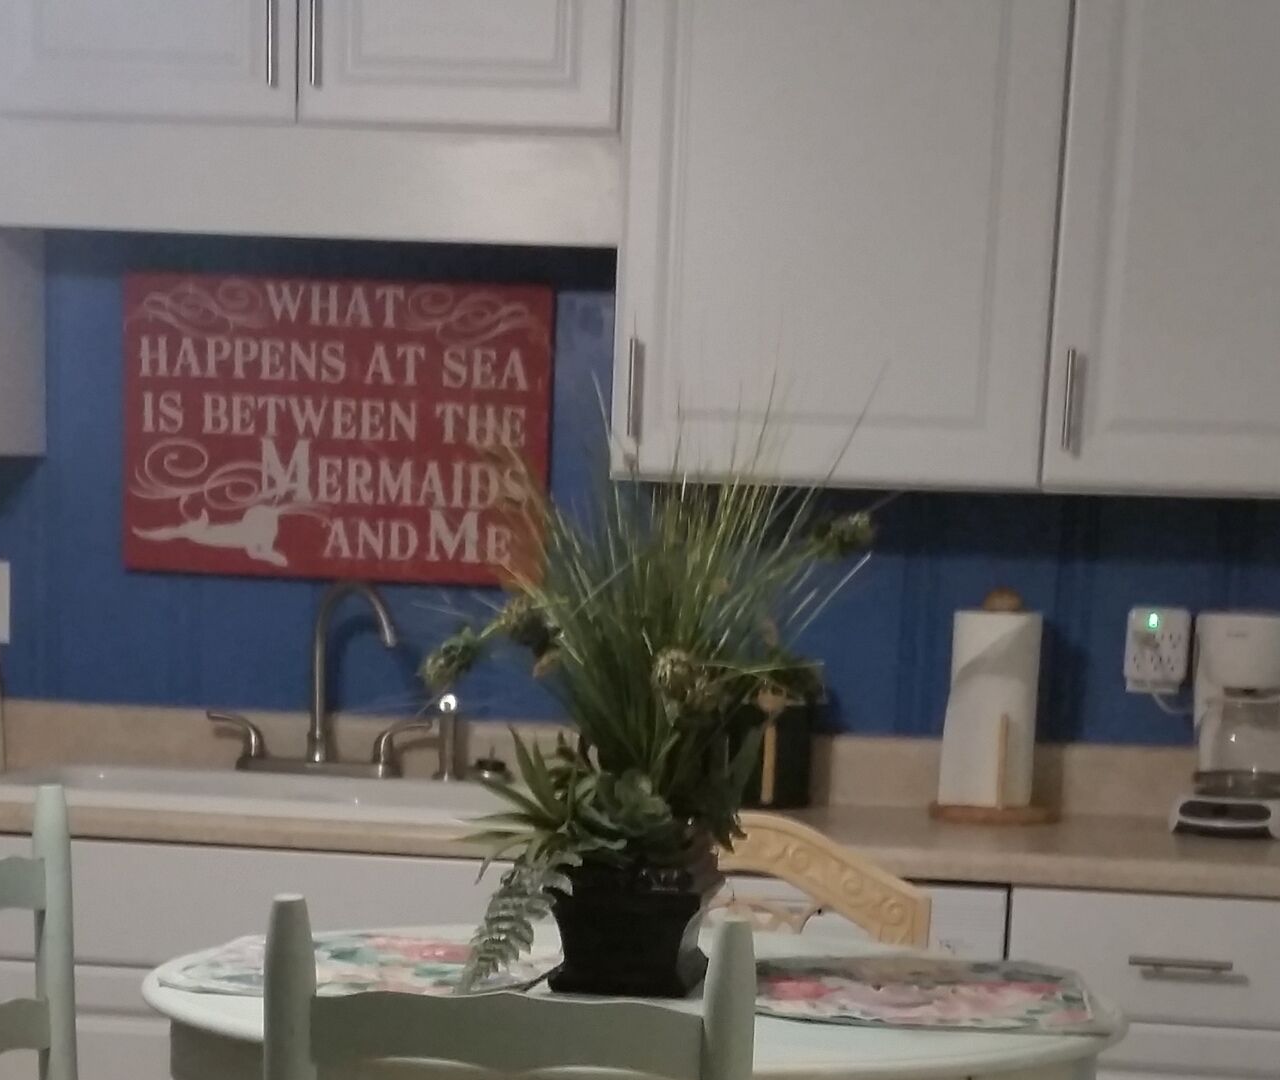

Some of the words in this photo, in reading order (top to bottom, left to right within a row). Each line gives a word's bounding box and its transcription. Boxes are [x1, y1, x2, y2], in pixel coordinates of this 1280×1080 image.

[266, 282, 406, 329] WHAT
[138, 335, 347, 384] HAPPENS
[363, 342, 426, 387] AT
[441, 346, 529, 392] SEA
[141, 390, 183, 435] IS
[202, 392, 418, 443] BETWEEN
[435, 404, 527, 449] THE
[260, 437, 529, 510] MERMAIDS
[321, 516, 419, 561] AND
